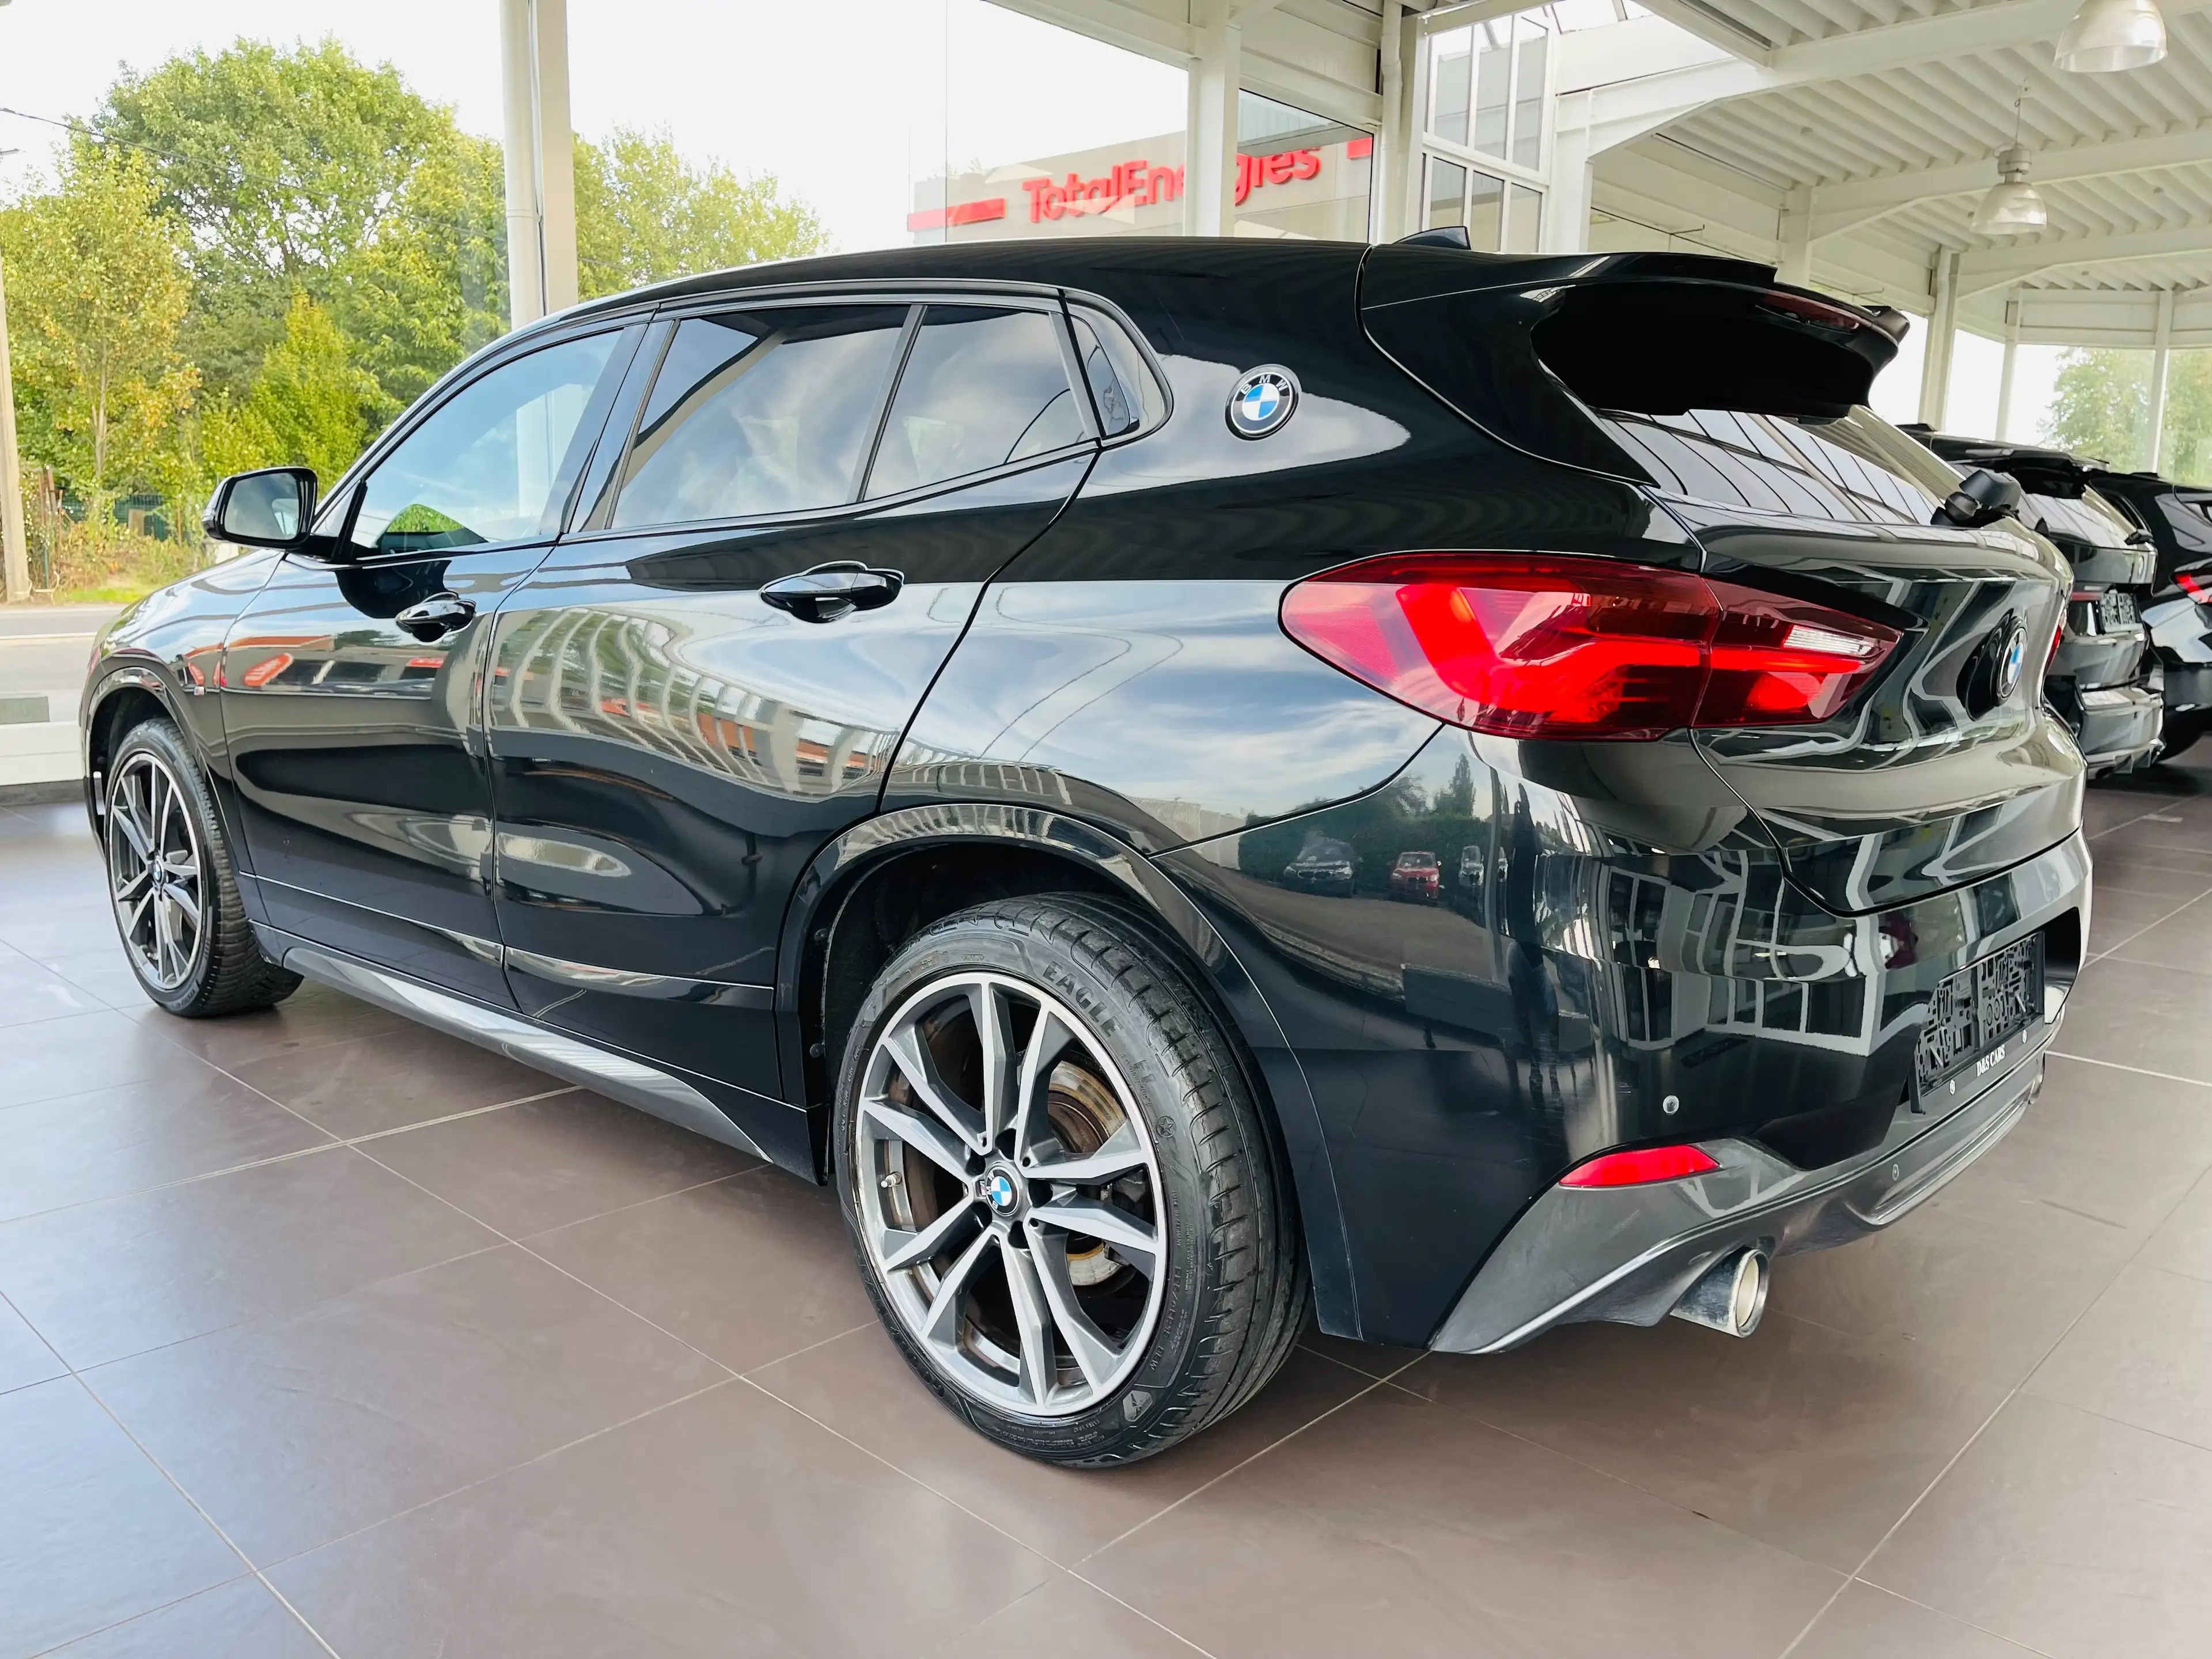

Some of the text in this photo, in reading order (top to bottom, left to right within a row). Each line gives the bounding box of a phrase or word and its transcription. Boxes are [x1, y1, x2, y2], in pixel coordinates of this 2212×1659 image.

[1021, 147, 1321, 224] TotalEngies
[1240, 374, 1288, 395] BMW
[1043, 960, 1124, 1037] EAGLE
[1976, 1044, 2005, 1077] D&S CARS
[986, 1170, 998, 1210] BMW
